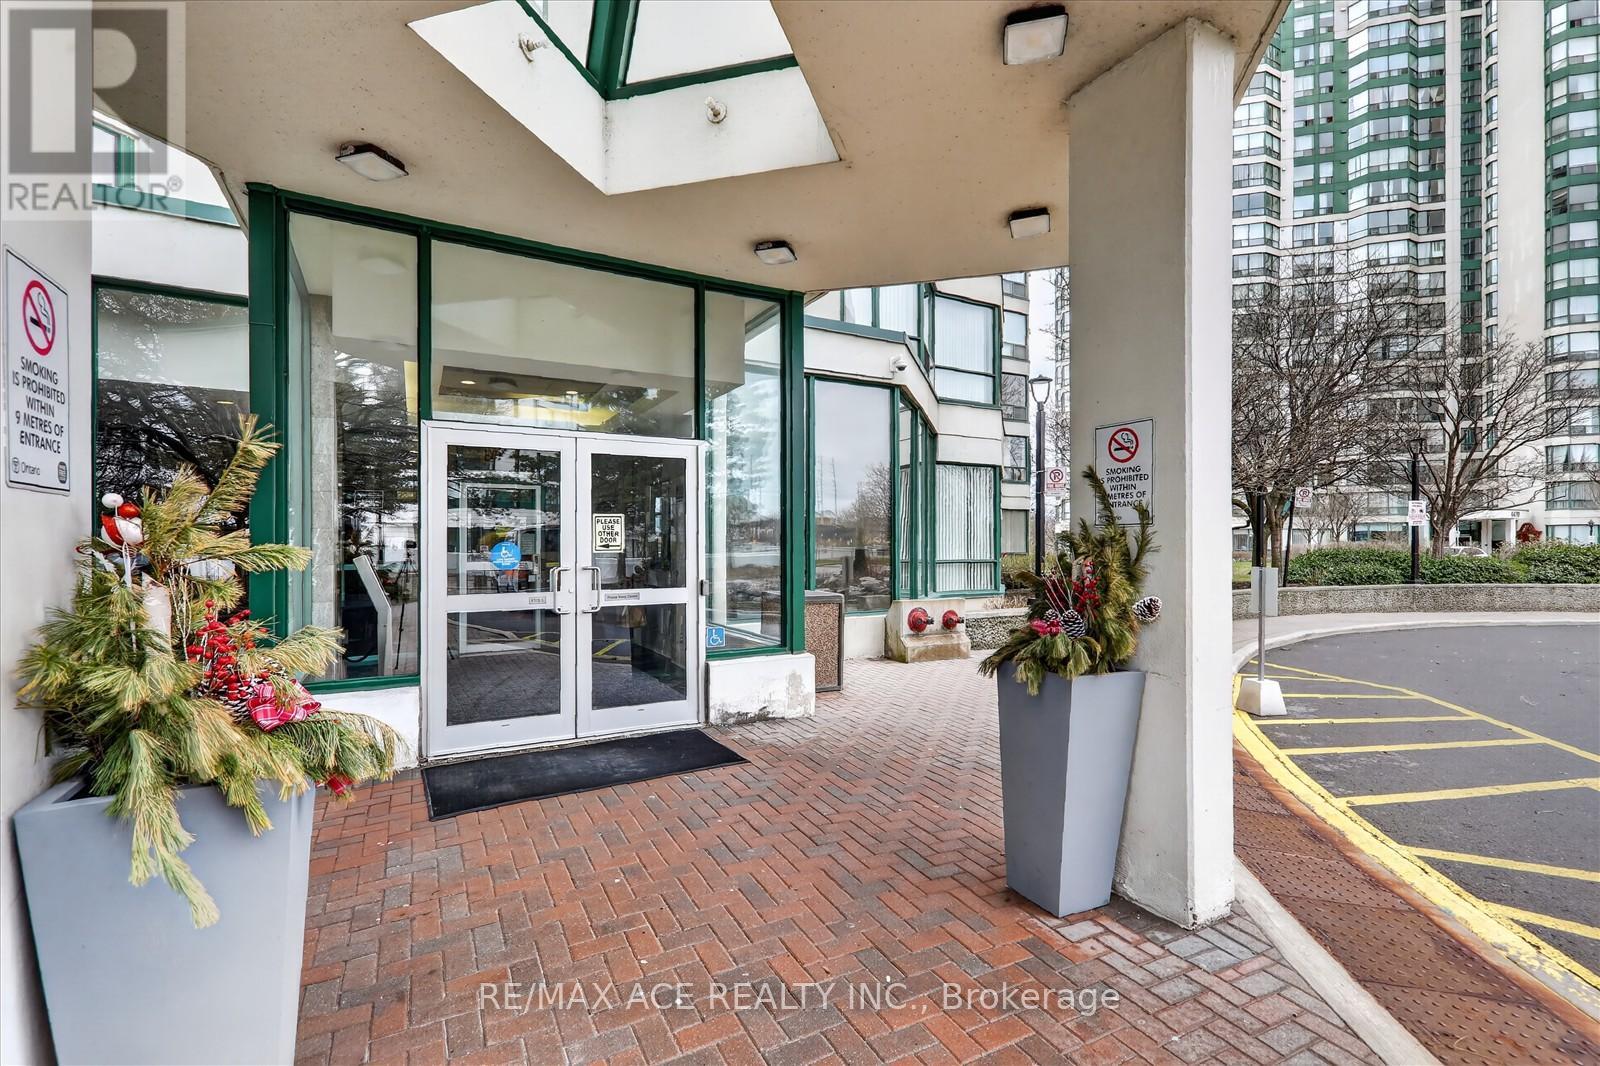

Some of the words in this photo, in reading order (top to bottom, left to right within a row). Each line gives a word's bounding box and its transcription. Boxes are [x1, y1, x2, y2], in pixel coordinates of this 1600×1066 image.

[20, 356, 59, 385] SMOKING
[12, 370, 20, 386] IS
[22, 375, 66, 405] PROHIBITED
[25, 395, 55, 418] WITHIN
[15, 410, 21, 425] 9
[23, 412, 52, 433] METRES
[54, 422, 64, 437] OF
[19, 430, 61, 455] ENTRANCE
[1106, 466, 1141, 475] SMOKING
[1106, 474, 1149, 483] PROHIBITED
